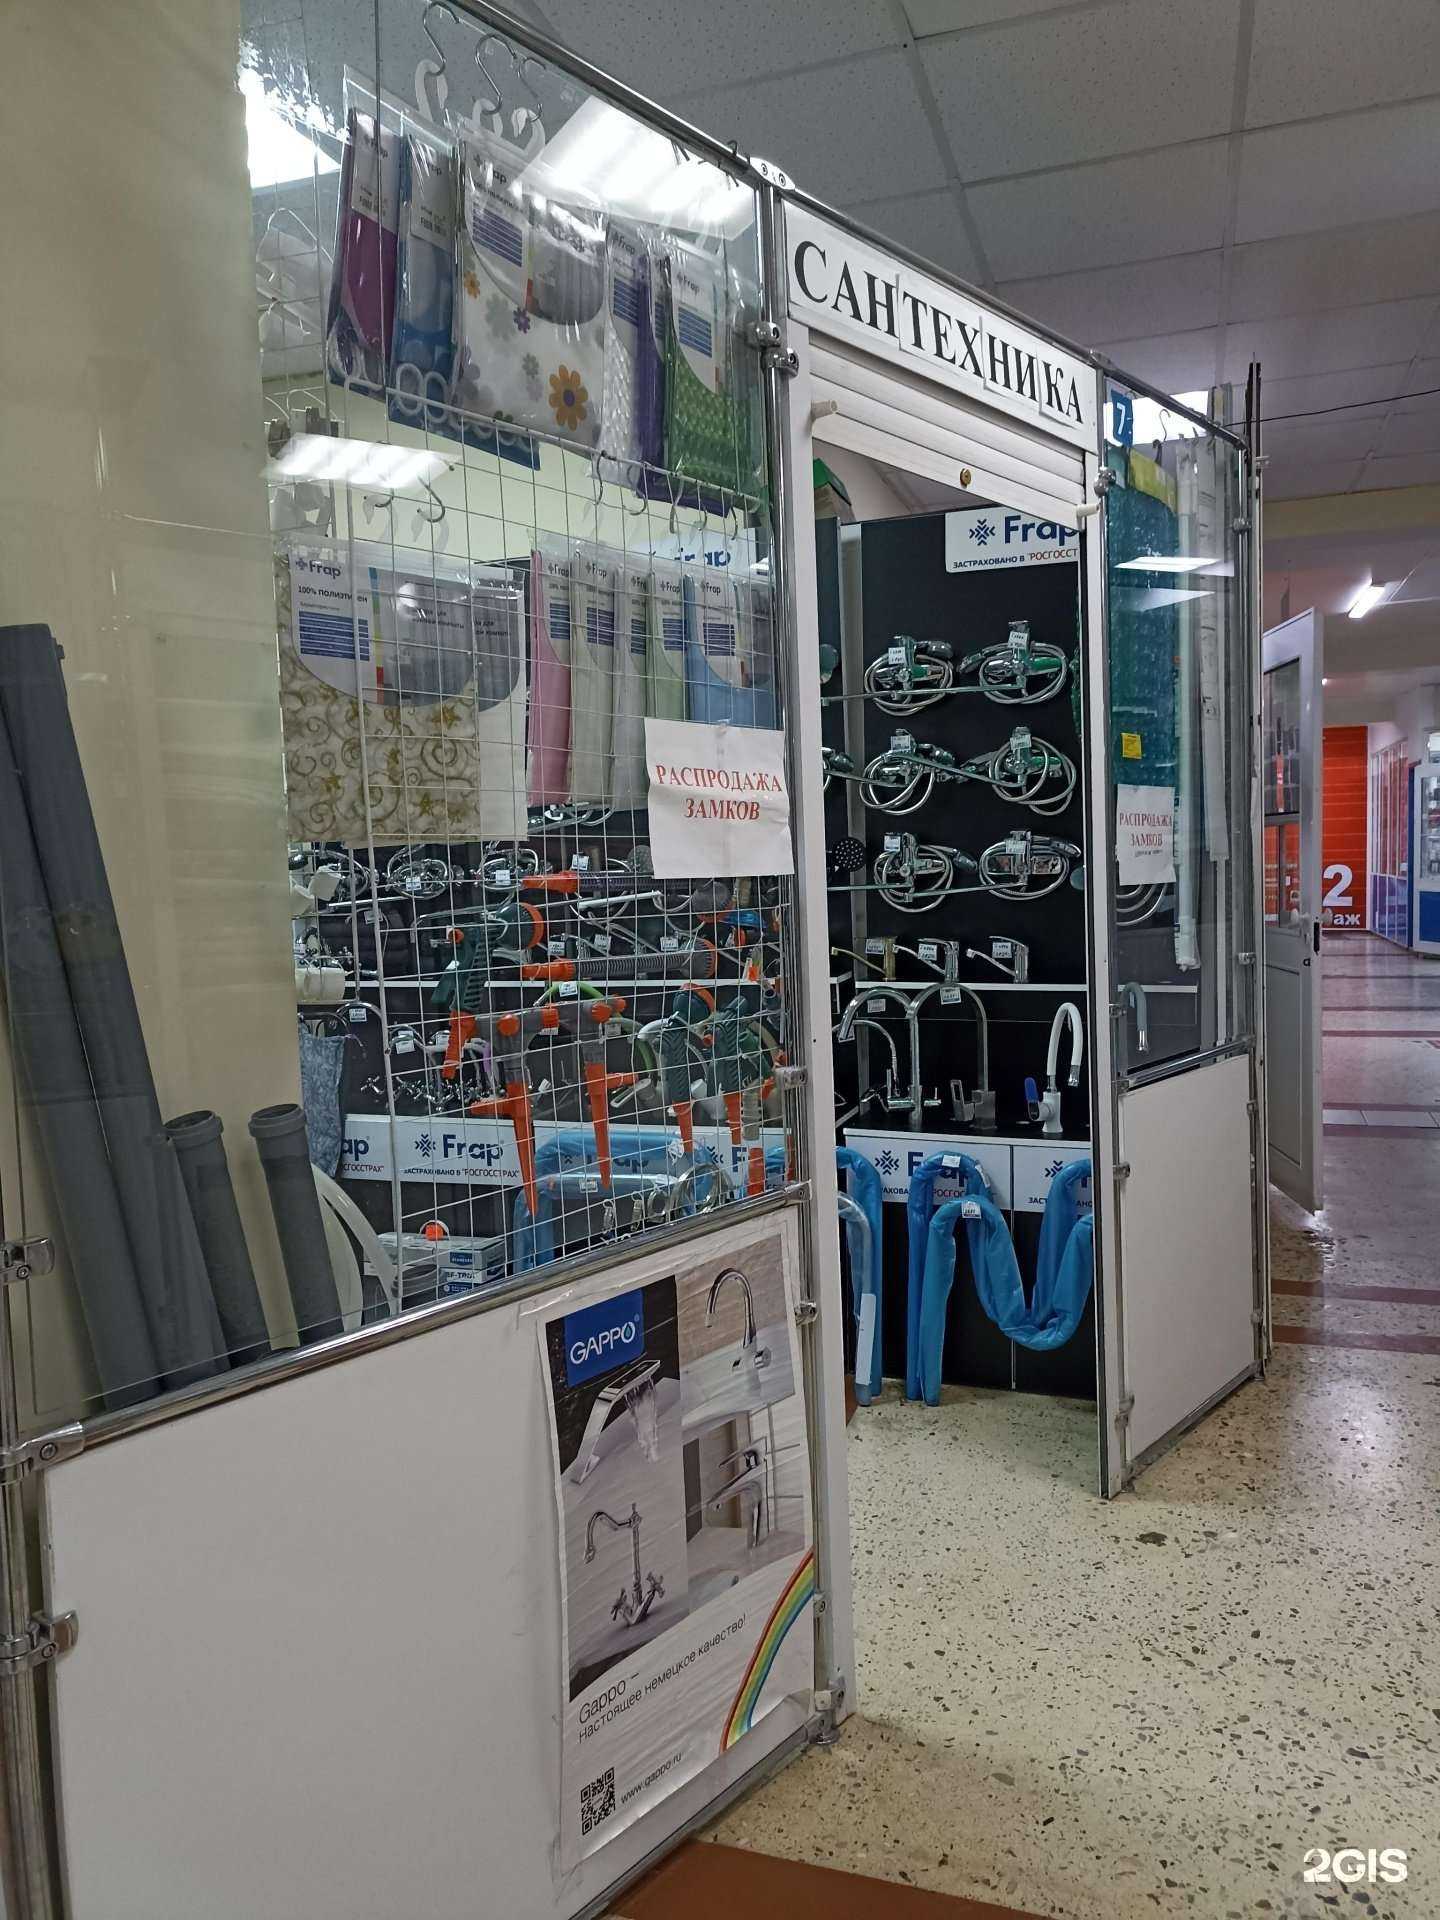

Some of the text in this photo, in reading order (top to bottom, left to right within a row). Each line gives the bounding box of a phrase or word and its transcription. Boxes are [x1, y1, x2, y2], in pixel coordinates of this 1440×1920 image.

[794, 240, 1084, 424] САНТЕХНИКА
[1116, 400, 1126, 436] 7
[309, 559, 342, 580] Frap
[953, 556, 1018, 569] ЗАСТРАХОВАНО
[655, 765, 783, 792] РАСПРОДАЖА
[684, 797, 761, 820] ЗАМКОВ
[1130, 833, 1163, 847] ЗАМКОВ
[1322, 864, 1353, 907] 2
[1332, 912, 1361, 926] аж
[341, 1138, 370, 1161] ap
[442, 1134, 504, 1166] Frap
[569, 1321, 636, 1366] GAPPO
[643, 1651, 696, 1693] немецкое
[698, 1613, 747, 1656] качество!
[579, 1680, 626, 1724] Gappo
[620, 1752, 683, 1804] www.gappo.ru
